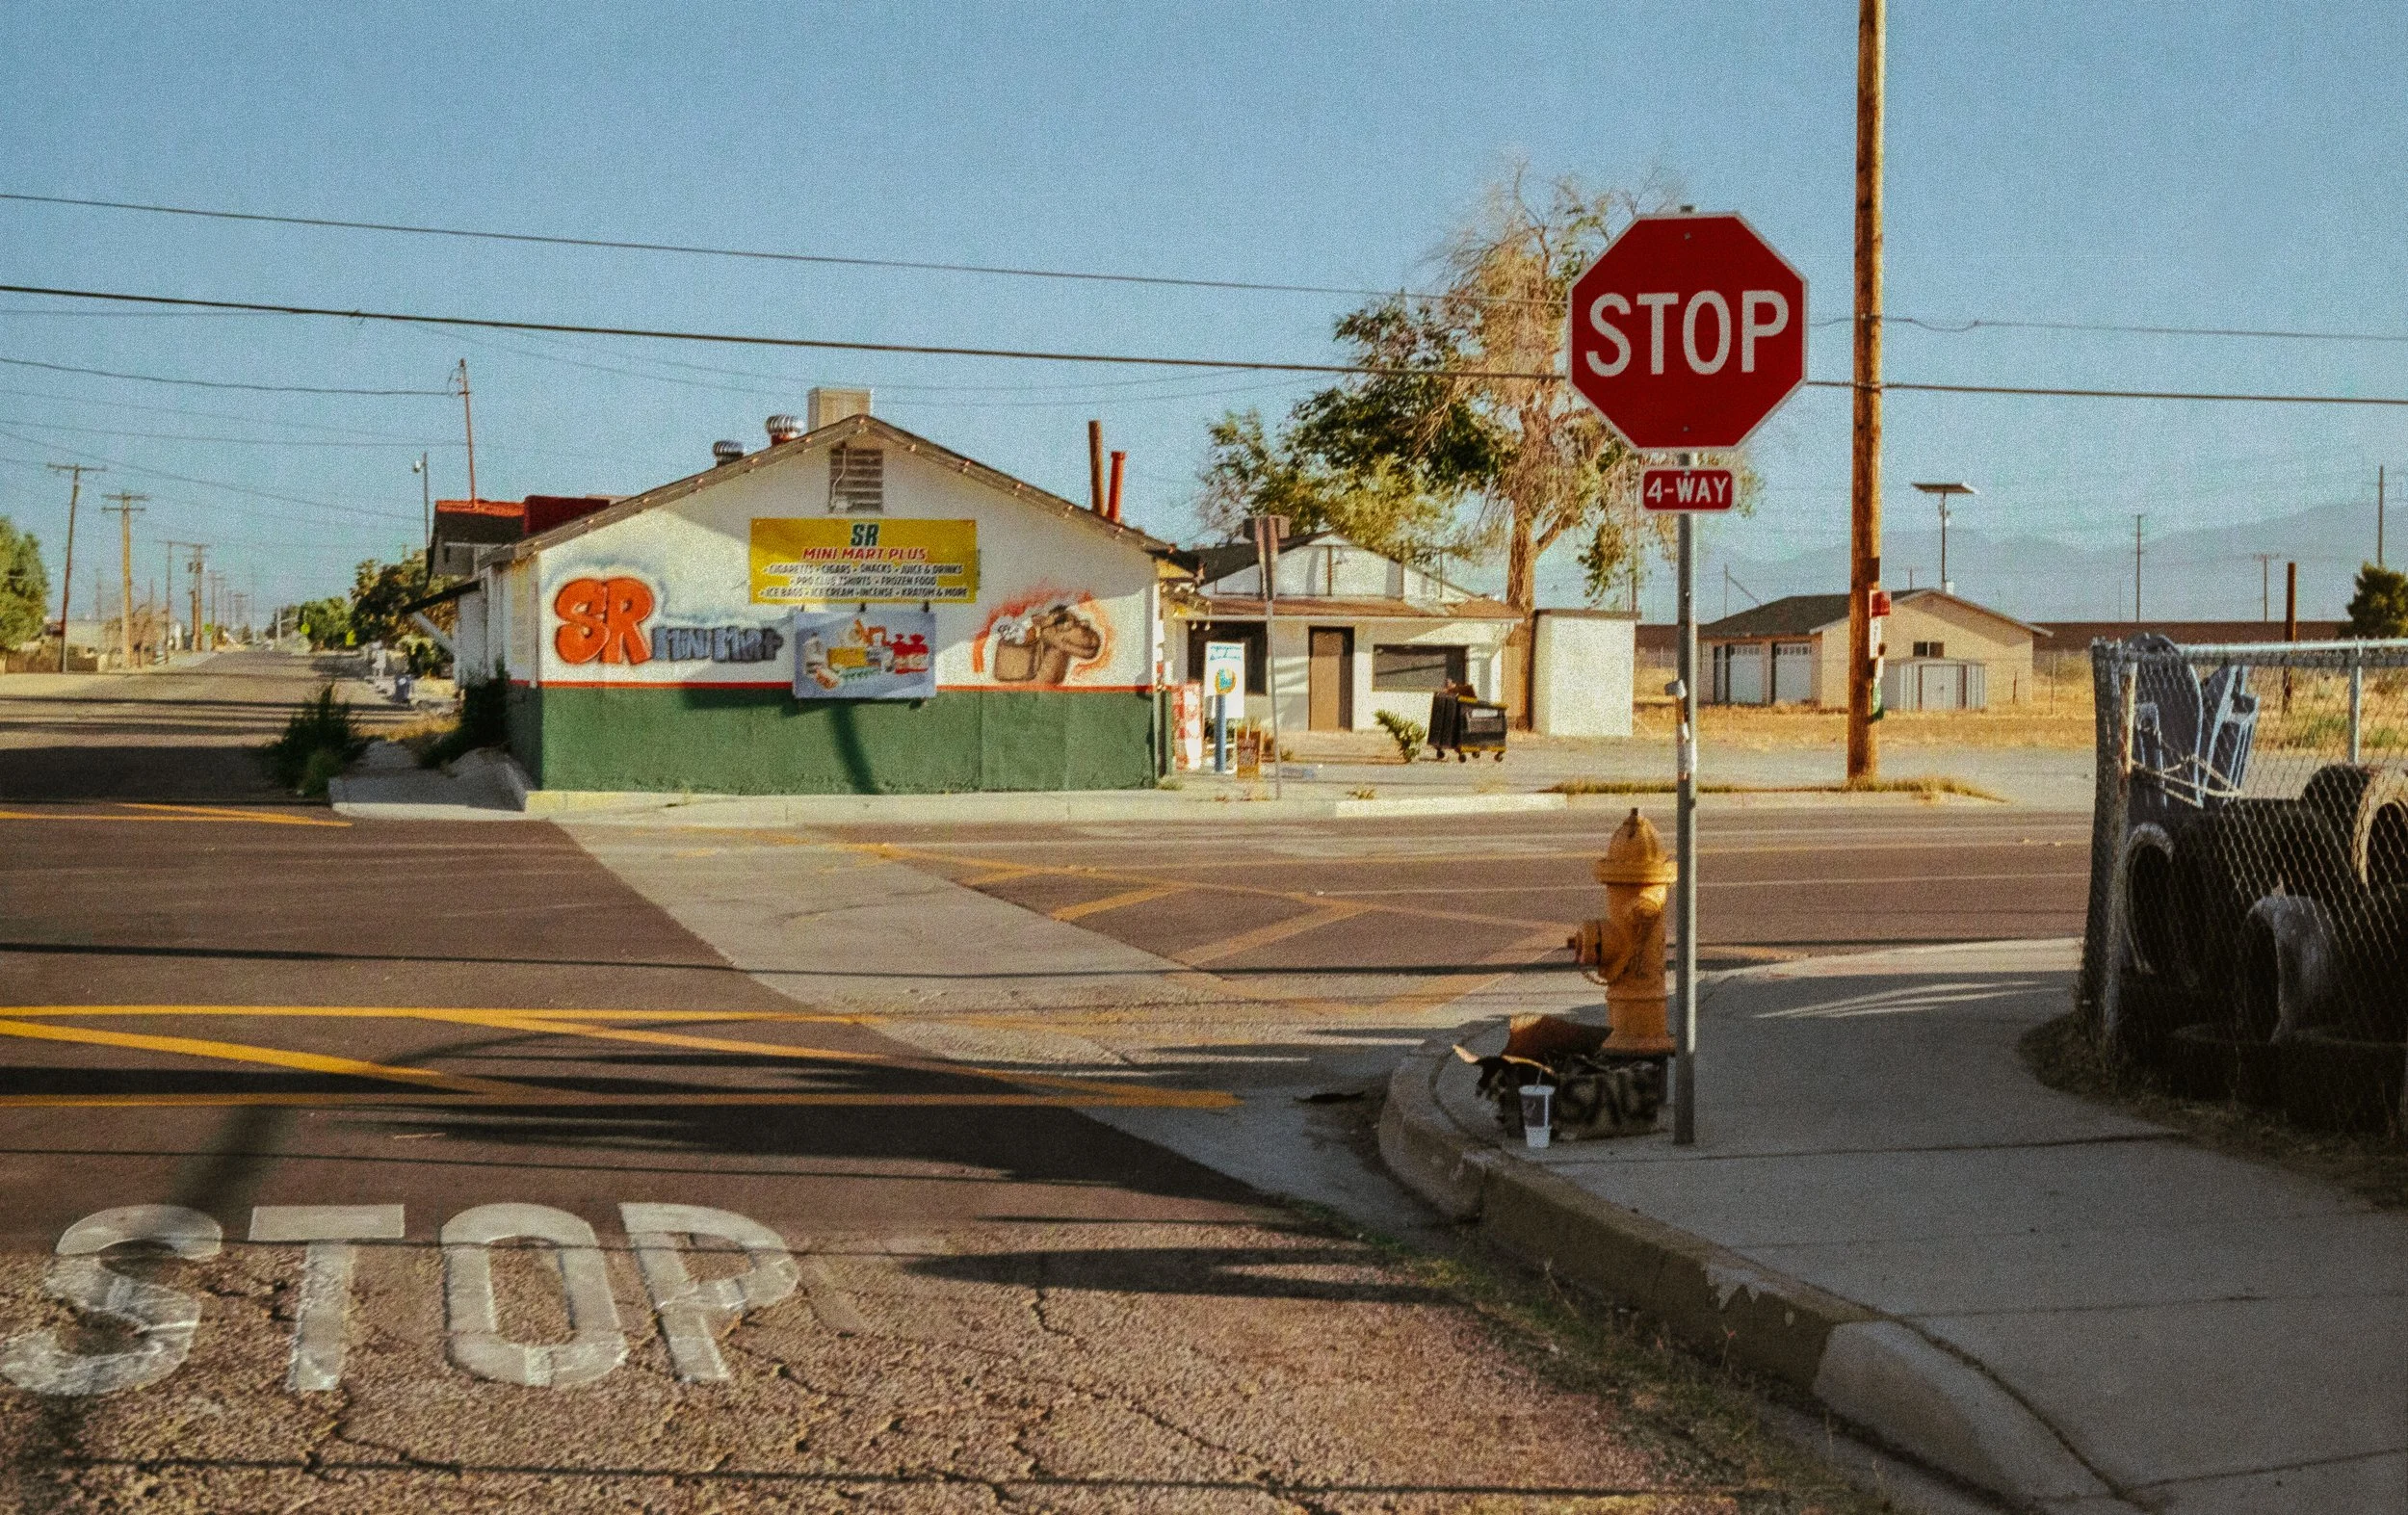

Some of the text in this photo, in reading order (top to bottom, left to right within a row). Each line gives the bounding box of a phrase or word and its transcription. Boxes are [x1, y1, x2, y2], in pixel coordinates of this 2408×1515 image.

[1585, 290, 1790, 377] STOP
[1646, 477, 1729, 504] 4-WAY
[850, 523, 879, 546] SR
[803, 547, 927, 560] MINI MART PLUS
[825, 588, 854, 597] CREAM
[914, 576, 936, 586] FOOD
[554, 577, 654, 666] SR
[0, 1202, 801, 1395] STOP
